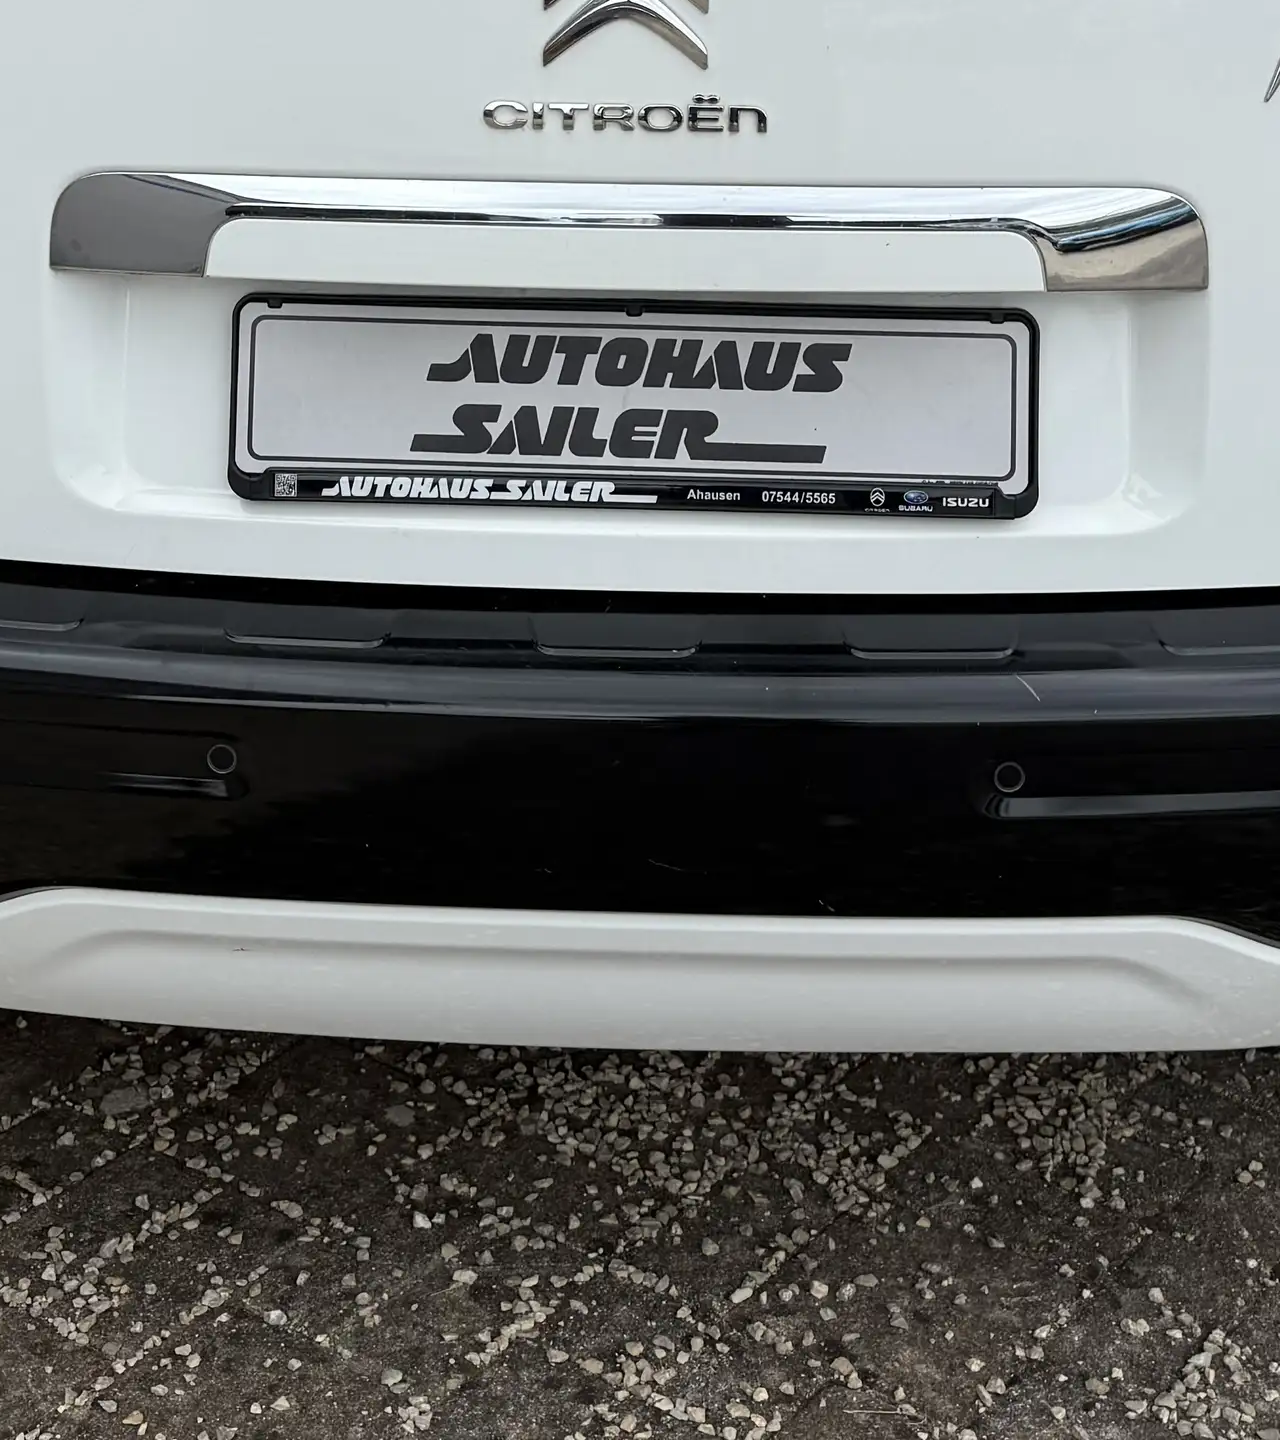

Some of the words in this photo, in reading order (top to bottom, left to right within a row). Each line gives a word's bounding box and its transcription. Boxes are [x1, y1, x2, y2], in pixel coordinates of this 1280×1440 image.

[426, 333, 853, 393] AUTOHAUS
[410, 403, 827, 464] SAILER
[321, 476, 493, 500] AUTOHAUS
[490, 479, 658, 503] SAILER
[687, 488, 741, 501] Ahausen
[761, 490, 837, 505] 07544/5565
[898, 504, 933, 513] SUBARU
[942, 496, 990, 509] ISUZU
